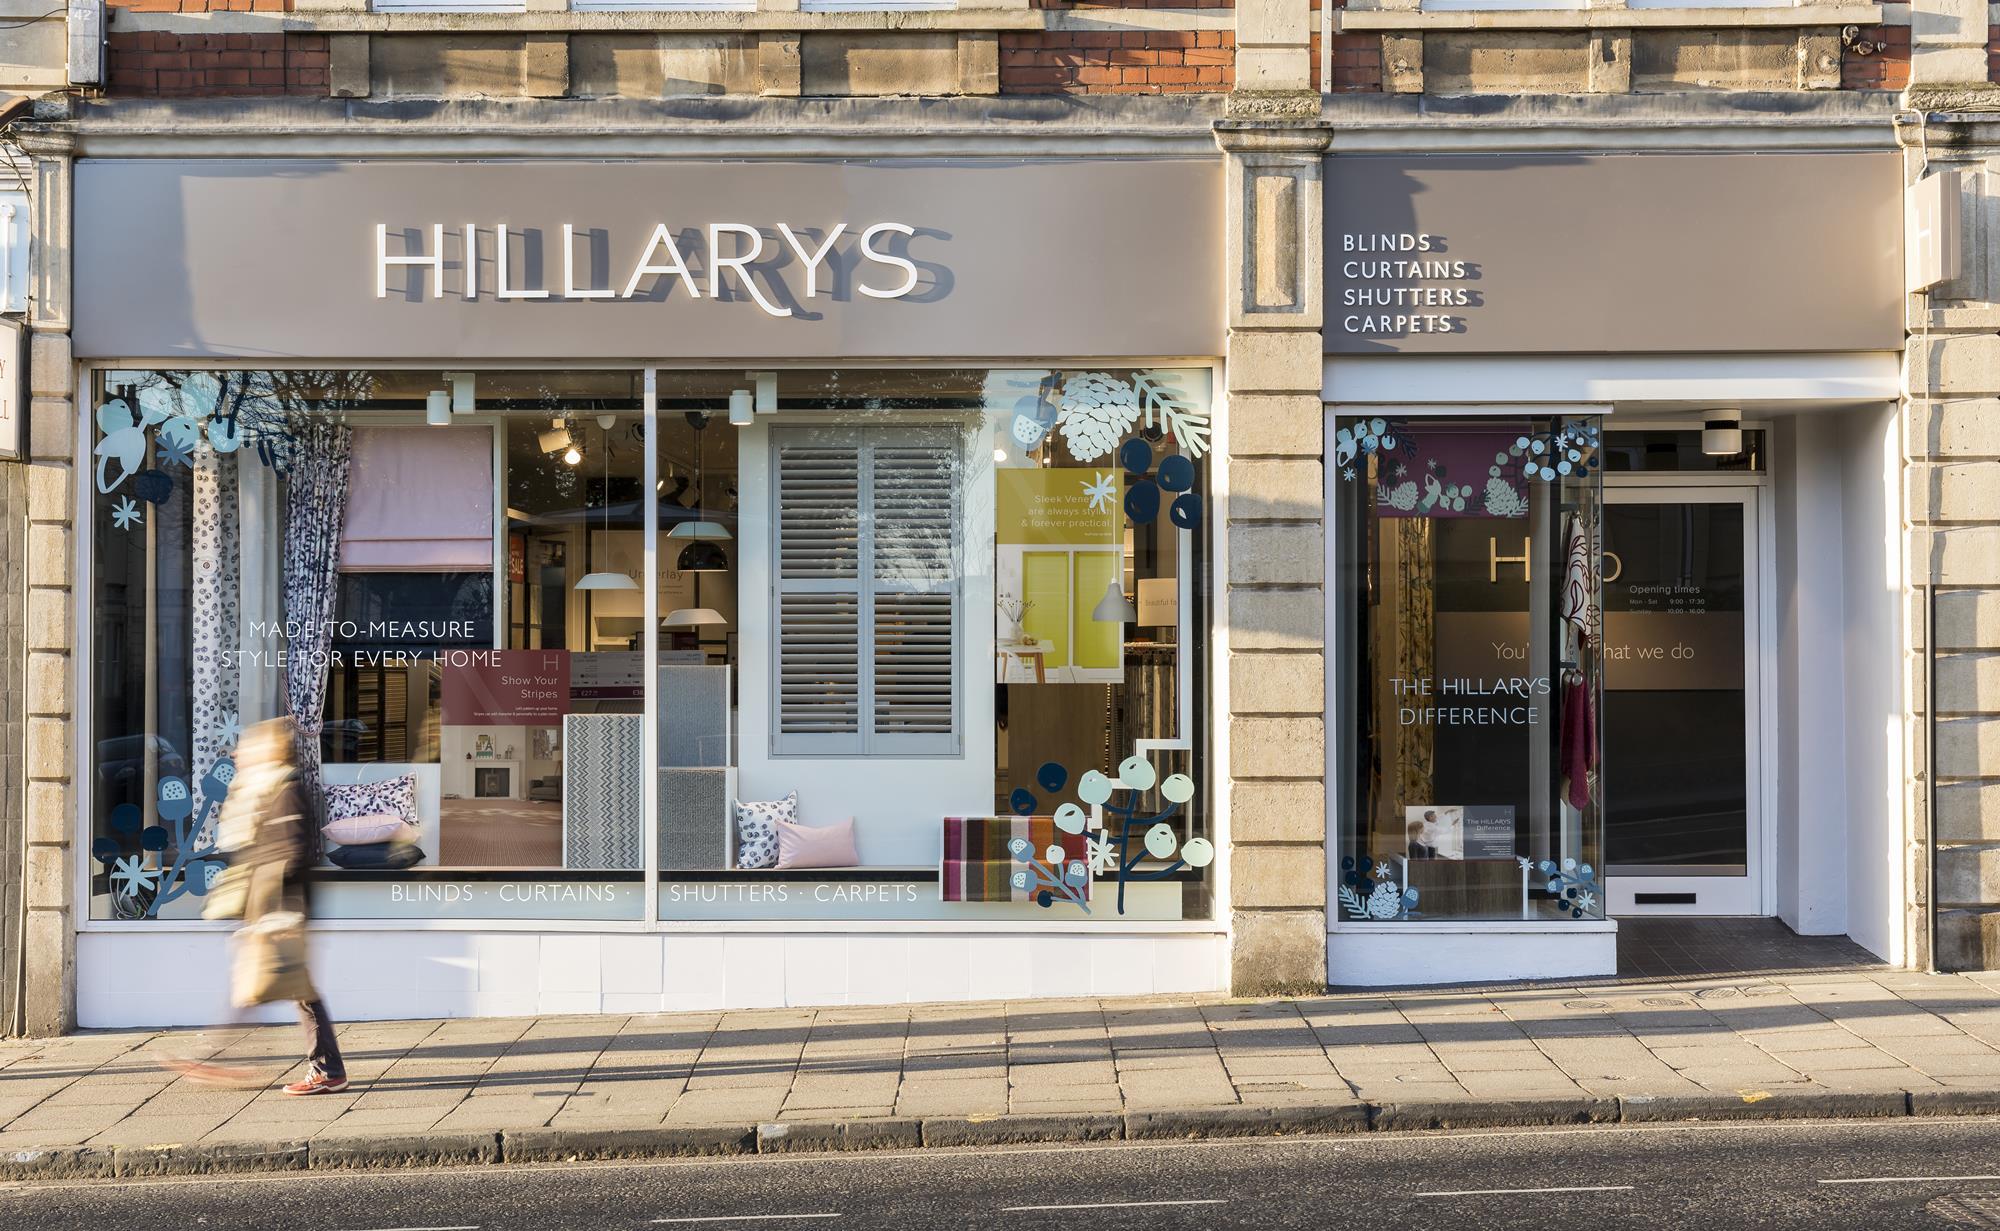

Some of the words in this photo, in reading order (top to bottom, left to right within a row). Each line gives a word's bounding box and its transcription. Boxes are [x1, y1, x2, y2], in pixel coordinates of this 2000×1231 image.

[1343, 234, 1431, 251] BLINDS
[376, 222, 918, 317] HILLARYS
[1343, 261, 1466, 279] CURTAINS
[1343, 288, 1468, 306] SHUTTERS
[1344, 315, 1452, 333] CARPETS
[1034, 495, 1062, 503] Sleek
[1028, 508, 1044, 516] are
[1047, 507, 1079, 517] always
[1021, 518, 1028, 527] &
[1031, 518, 1066, 527] forever
[1629, 585, 1672, 595] Opening
[1674, 585, 1701, 594] times
[249, 620, 475, 638] MADE-TO-MEASURE
[221, 650, 288, 668] STYLE
[299, 650, 344, 668] FOR
[354, 650, 422, 668] EVERY
[433, 650, 501, 667] HOME
[1637, 646, 1664, 660] we
[1671, 642, 1695, 660] do
[501, 675, 532, 686] Show
[534, 675, 558, 686] Your
[1389, 678, 1432, 696] THE
[1443, 678, 1551, 699] HILLARYS
[520, 689, 558, 700] Stripes
[1400, 707, 1539, 725] DIFFERENCE
[391, 884, 473, 902] BLINDS
[499, 884, 616, 902] CURTAINS
[670, 884, 788, 902] SHUTTERS
[814, 884, 918, 902] CARPETS
